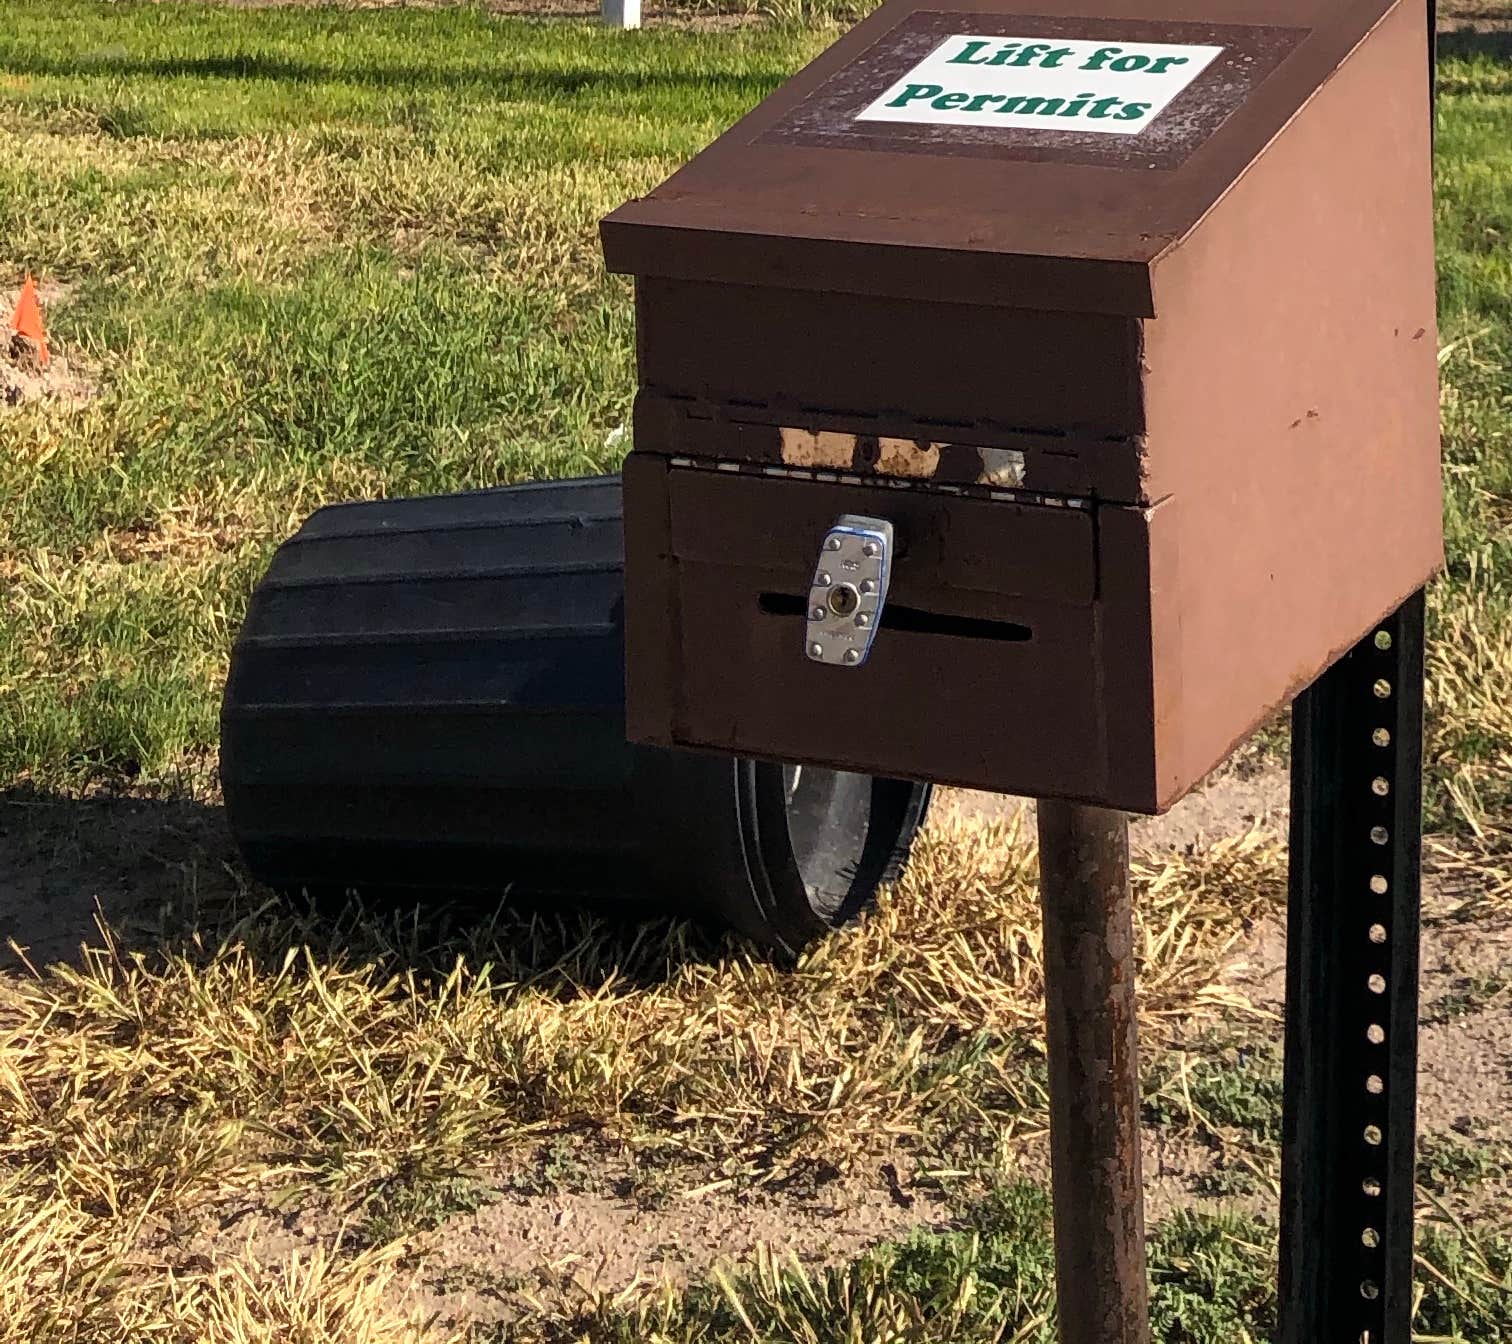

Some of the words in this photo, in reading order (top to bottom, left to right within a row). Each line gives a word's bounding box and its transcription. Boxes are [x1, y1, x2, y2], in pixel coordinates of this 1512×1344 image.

[946, 40, 1074, 69] Lift
[1078, 45, 1189, 74] for
[885, 83, 1152, 121] Permits
